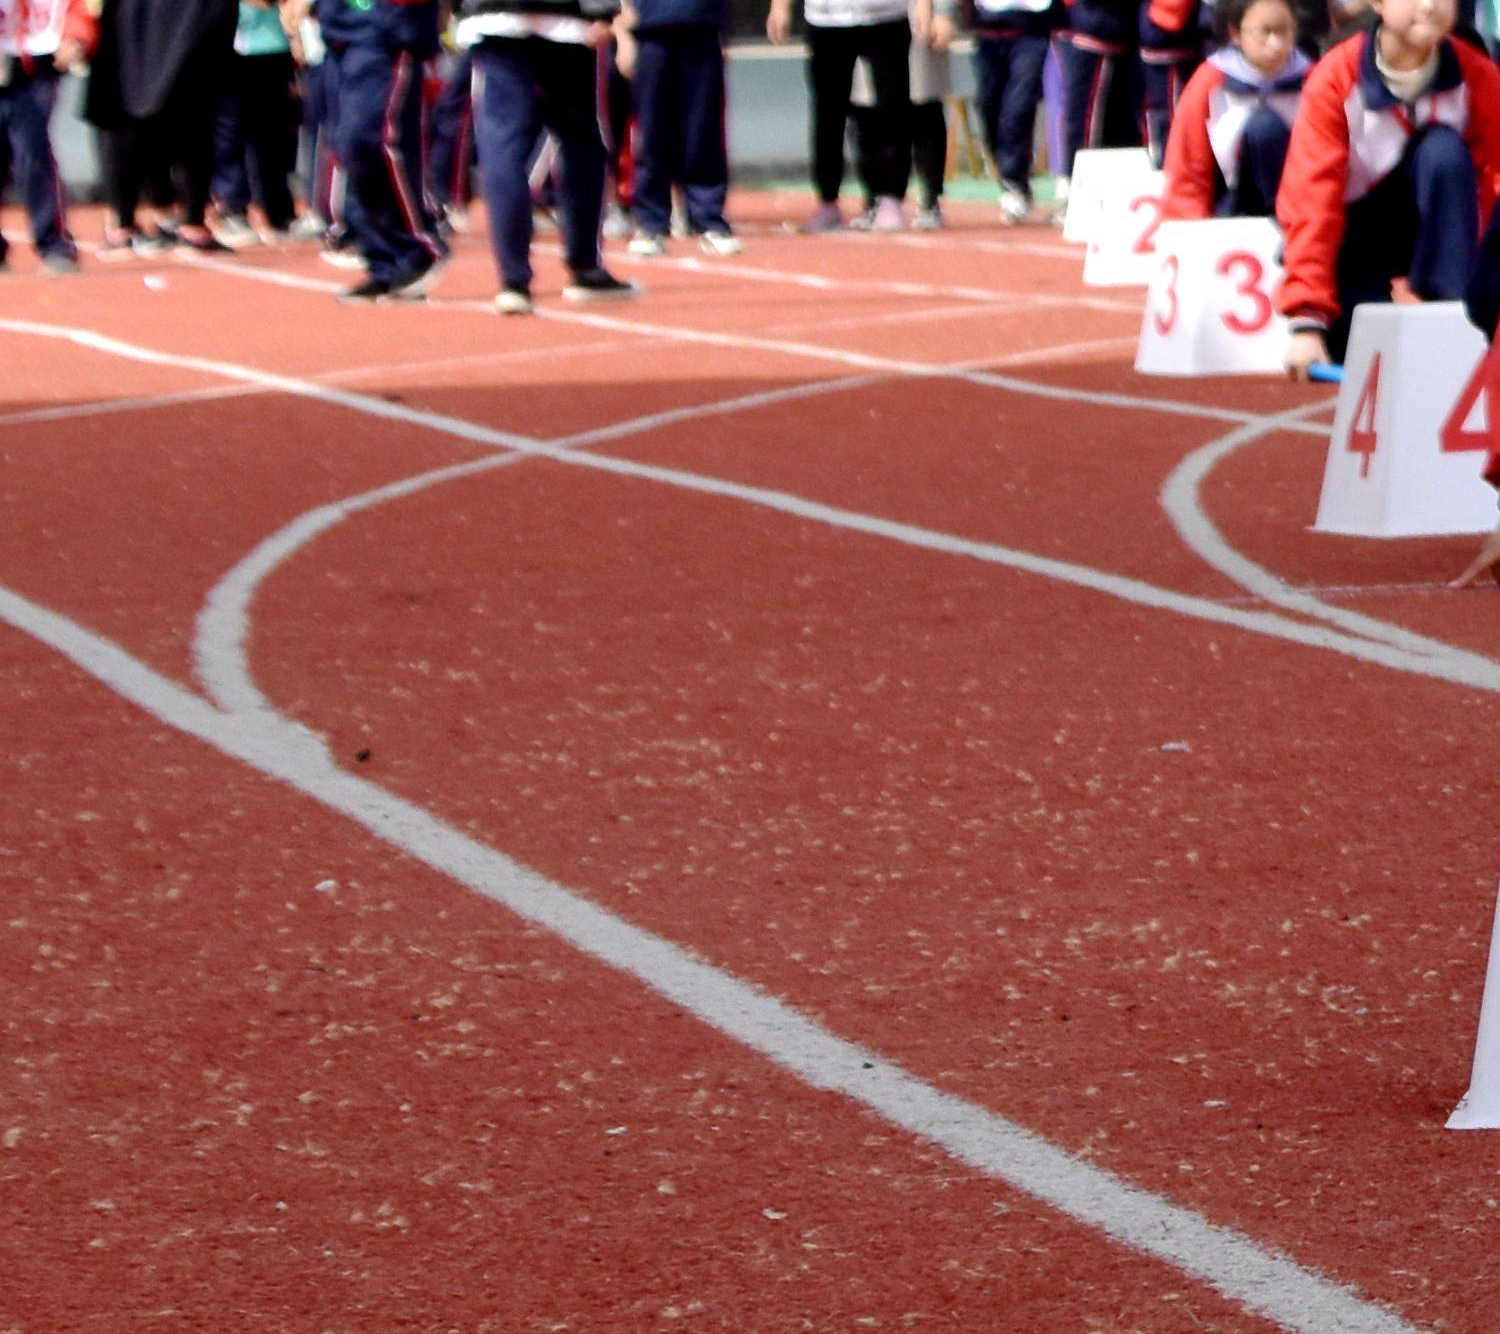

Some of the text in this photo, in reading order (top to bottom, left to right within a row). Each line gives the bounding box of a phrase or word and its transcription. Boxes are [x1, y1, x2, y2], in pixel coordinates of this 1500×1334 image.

[1128, 194, 1163, 255] 2
[1154, 252, 1180, 338] 3
[1214, 248, 1274, 336] 3
[1347, 353, 1382, 479] 4
